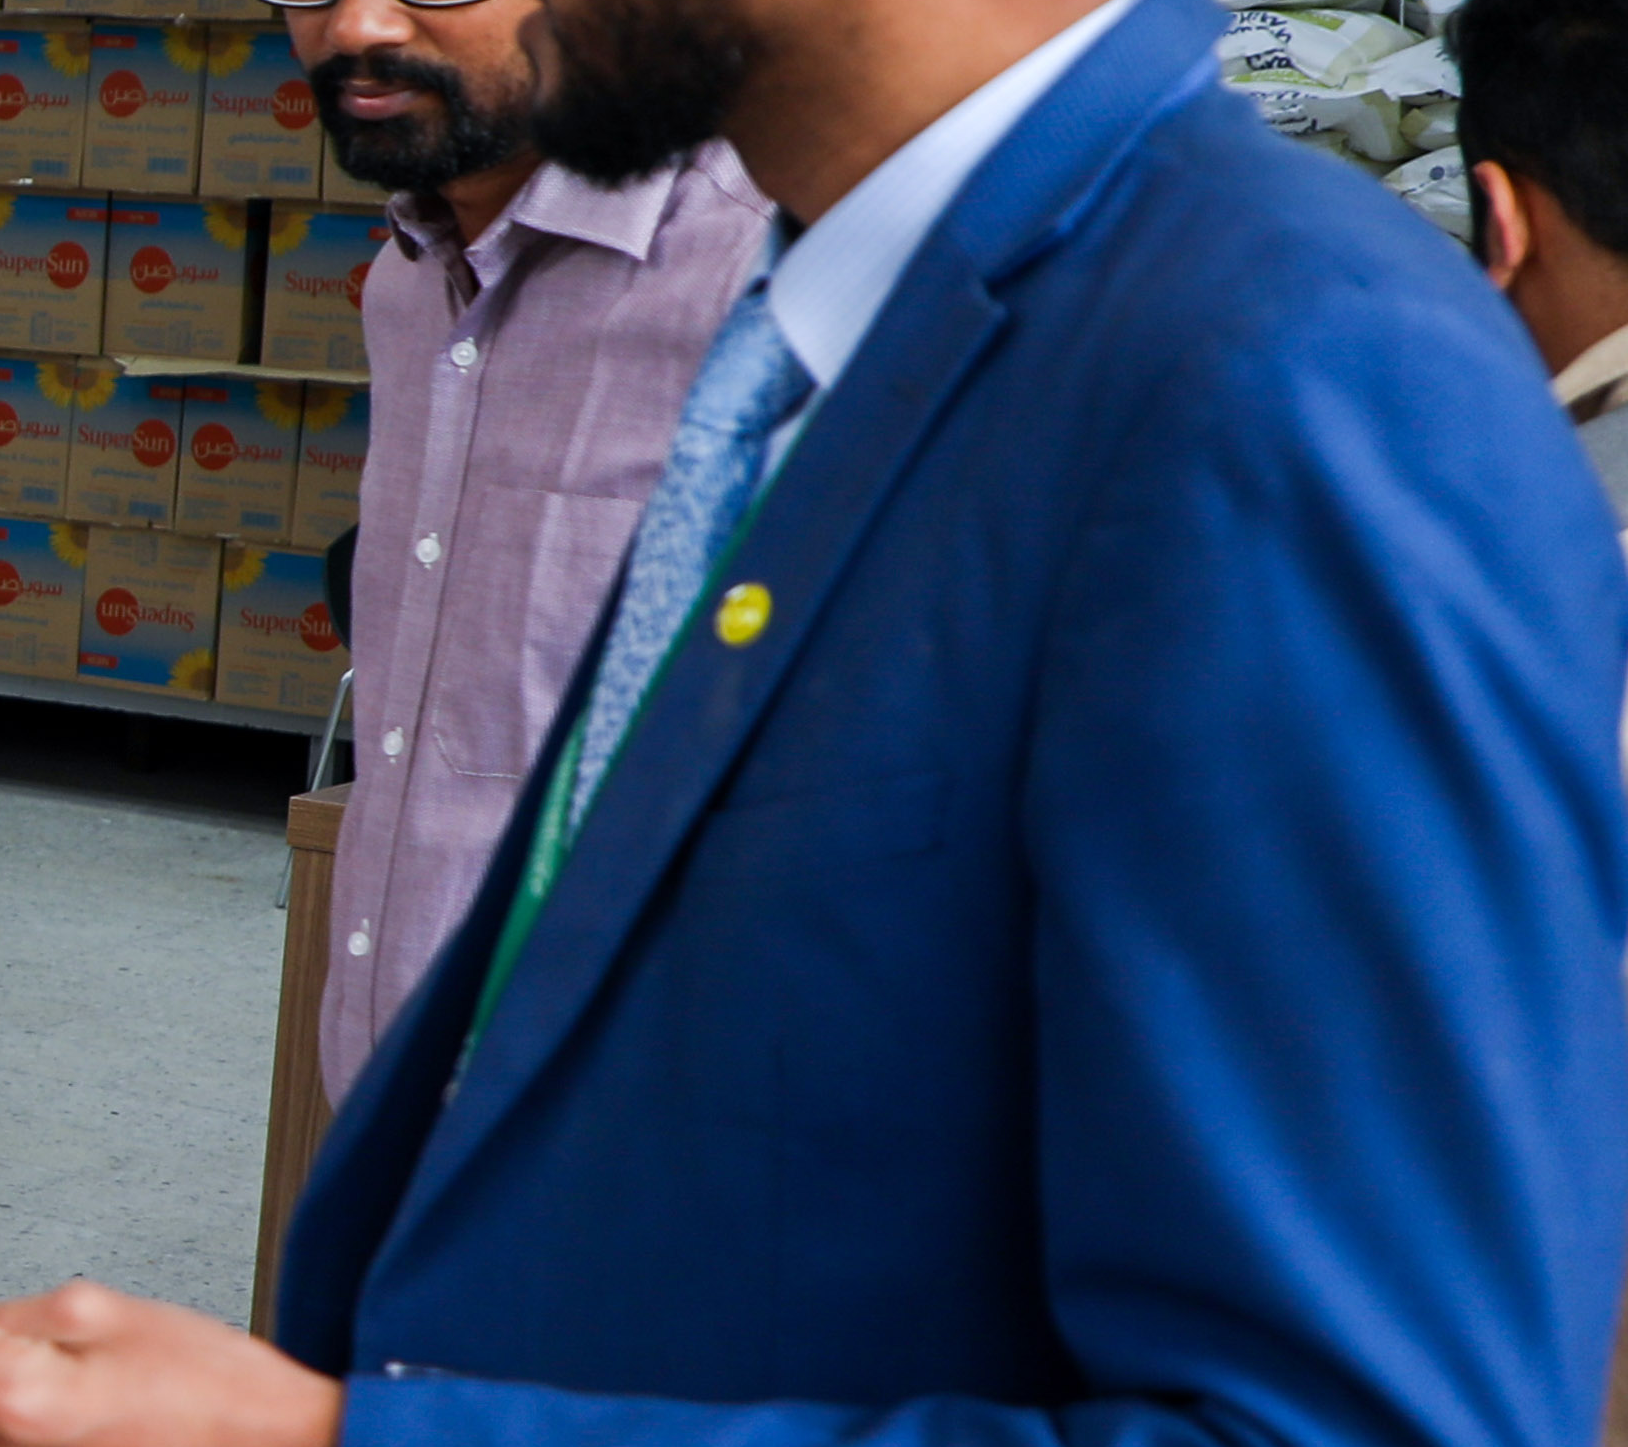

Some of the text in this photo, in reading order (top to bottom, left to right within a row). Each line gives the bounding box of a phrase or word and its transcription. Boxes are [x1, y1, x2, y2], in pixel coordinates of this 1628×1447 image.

[211, 91, 314, 115] SuperSun
[284, 268, 364, 297] SuperS
[78, 427, 171, 455] SuperSun
[305, 446, 365, 473] Super
[99, 598, 195, 633] SuperSun
[240, 608, 340, 636] SuperSu
